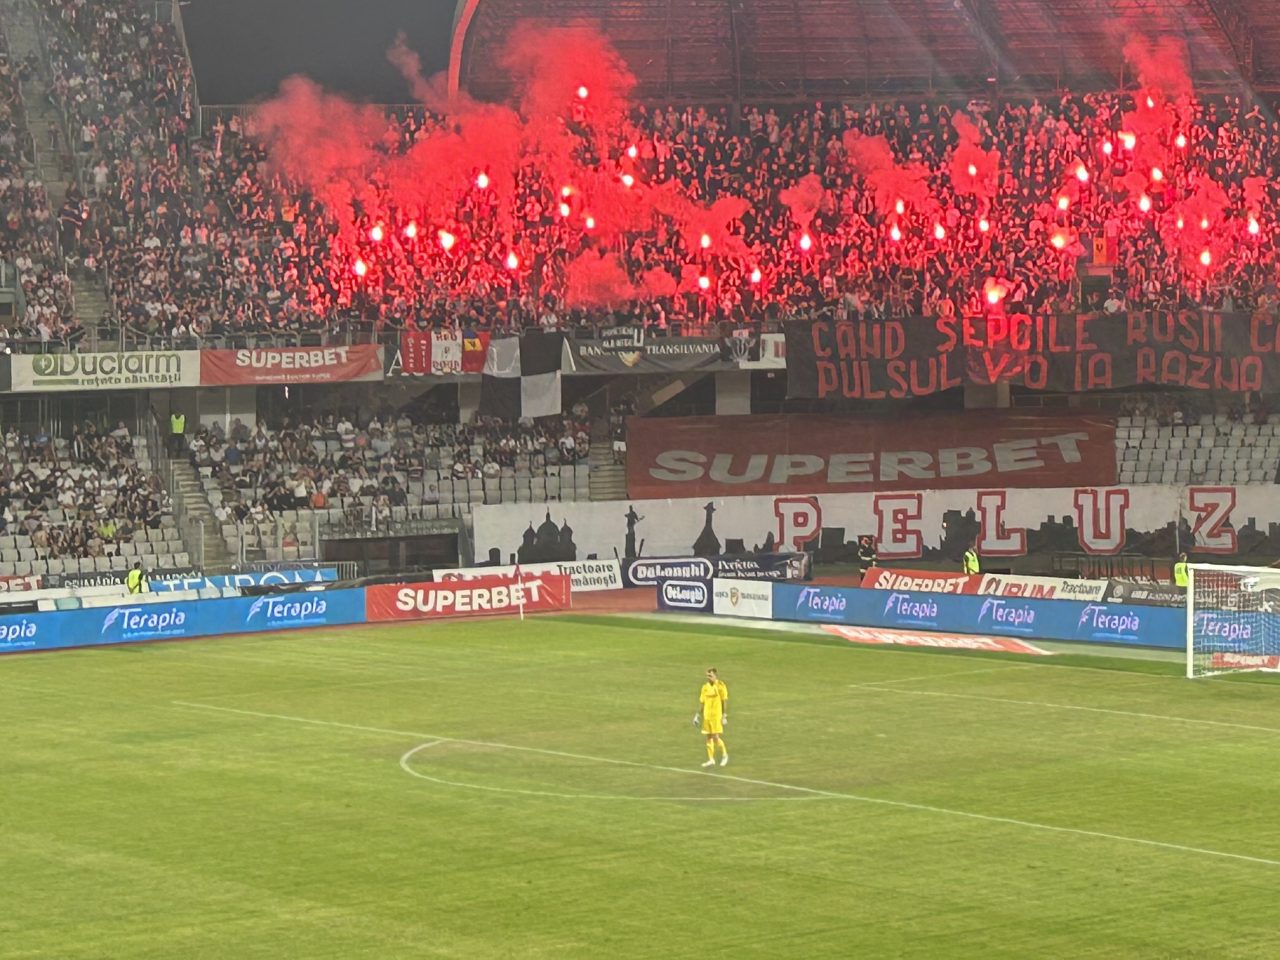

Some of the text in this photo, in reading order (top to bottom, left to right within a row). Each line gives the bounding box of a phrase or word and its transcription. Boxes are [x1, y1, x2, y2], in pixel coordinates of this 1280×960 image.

[236, 345, 350, 369] SUPERBET
[645, 343, 721, 355] TRANSILVANIA
[815, 352, 962, 399] PULSUL
[1073, 352, 1113, 391] IA
[1135, 346, 1264, 392] RAZNA
[649, 432, 1089, 484] SUPERBET
[874, 570, 970, 594] SUPERBET
[262, 596, 328, 620] Terapia
[395, 578, 544, 613] SUPERBET
[805, 588, 847, 613] Terapia
[893, 593, 938, 619] Terapia
[118, 607, 187, 634] Terapia
[989, 599, 1036, 625] Terapia
[1089, 605, 1141, 634] Terapia
[1198, 613, 1252, 641] Terapia
